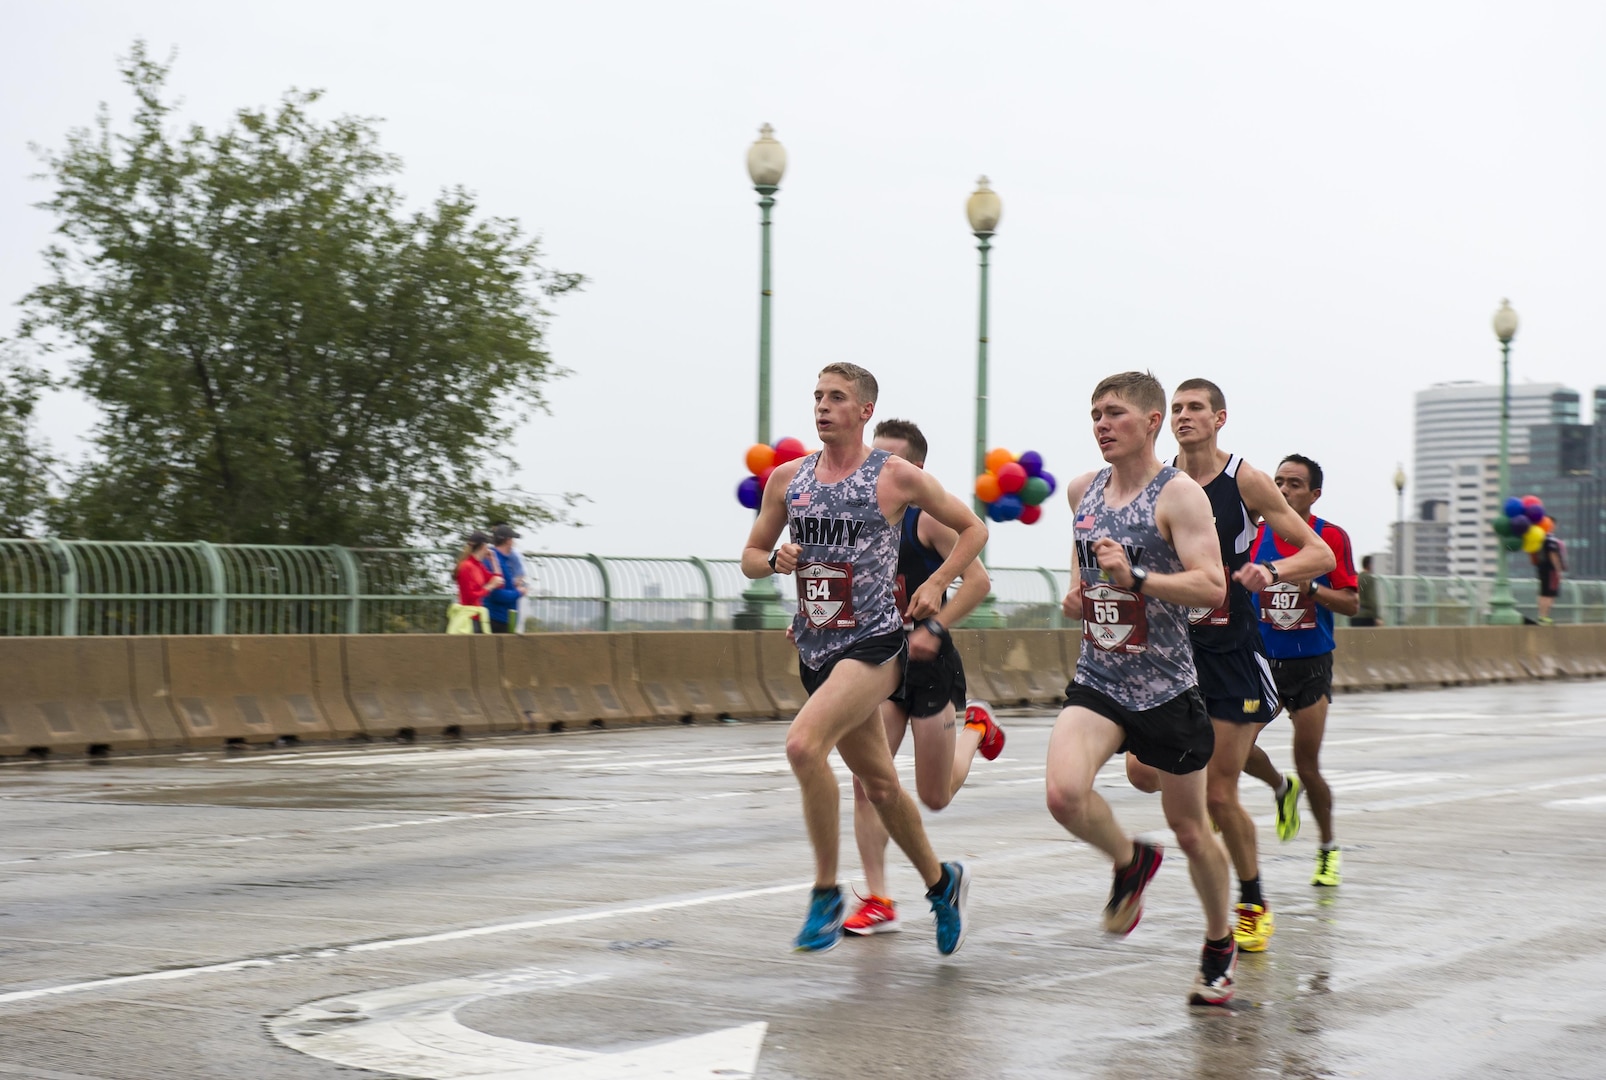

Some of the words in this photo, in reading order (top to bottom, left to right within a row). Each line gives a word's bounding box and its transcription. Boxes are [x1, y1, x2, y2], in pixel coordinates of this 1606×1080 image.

[794, 516, 865, 548] ARMY
[806, 579, 830, 600] 54
[1271, 592, 1300, 609] 497
[1093, 601, 1119, 623] 55
